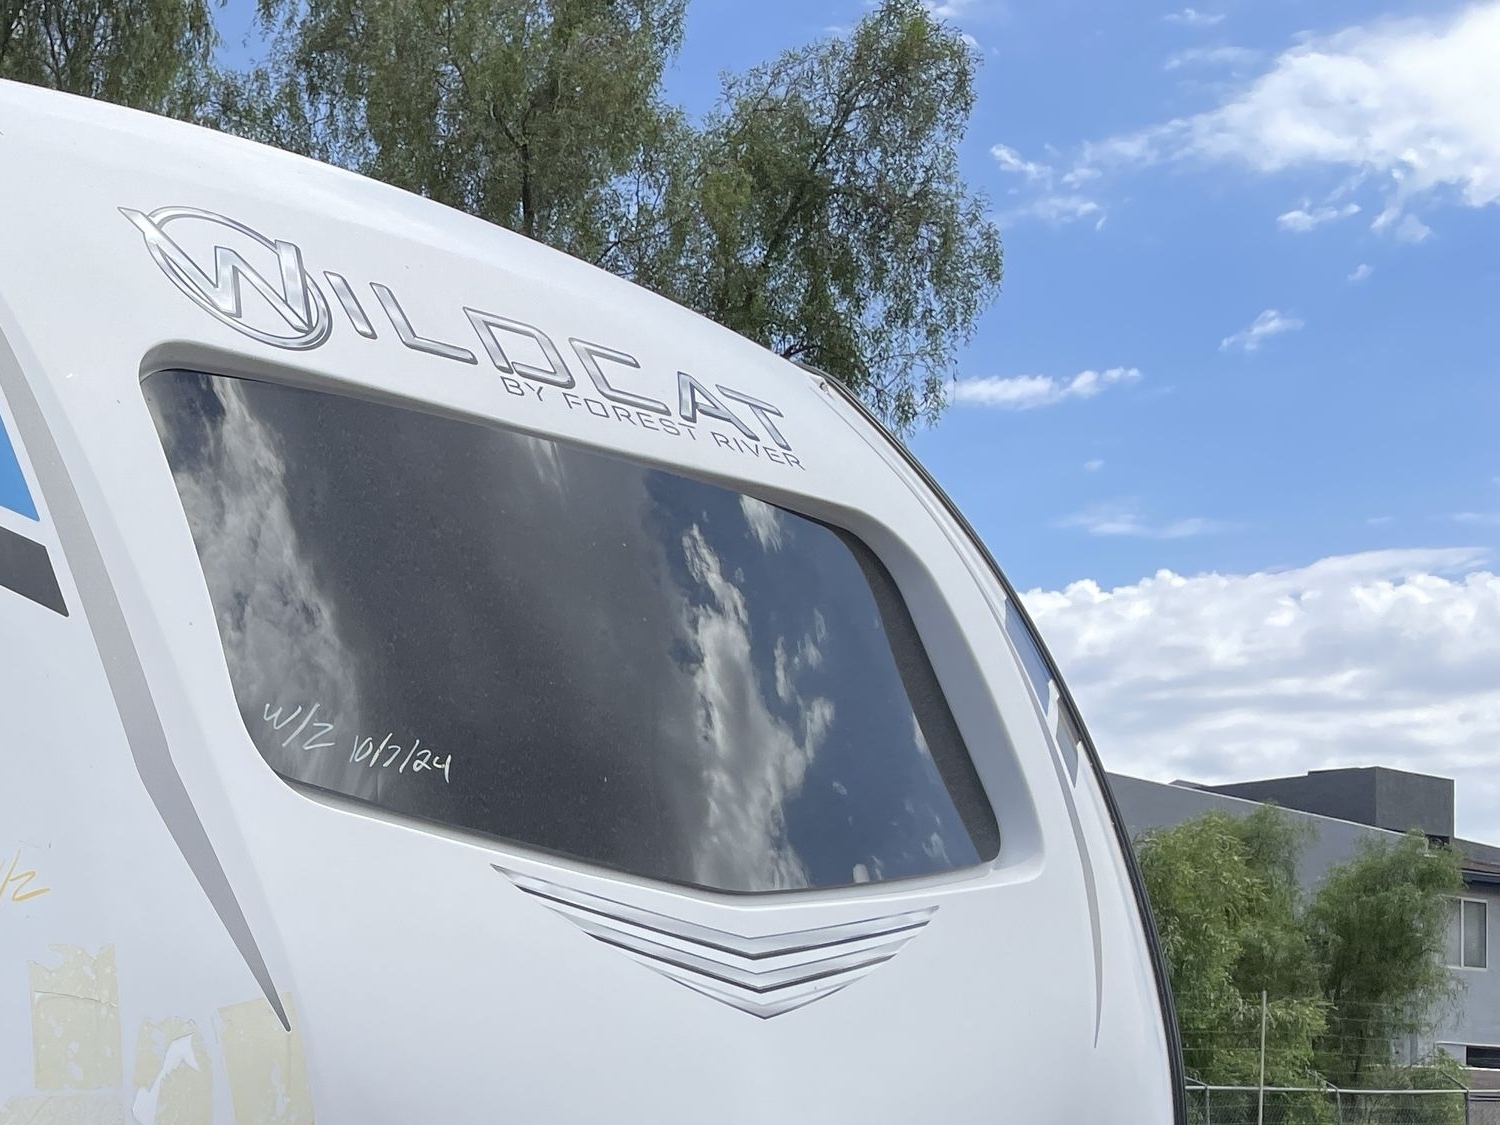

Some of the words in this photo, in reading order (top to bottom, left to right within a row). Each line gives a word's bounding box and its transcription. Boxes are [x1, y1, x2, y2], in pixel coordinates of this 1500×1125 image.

[118, 206, 798, 450] WILDCAT
[500, 376, 544, 402] BY
[561, 392, 696, 441] FOREST
[710, 430, 806, 471] RIVER
[349, 732, 452, 783] 10/7/24
